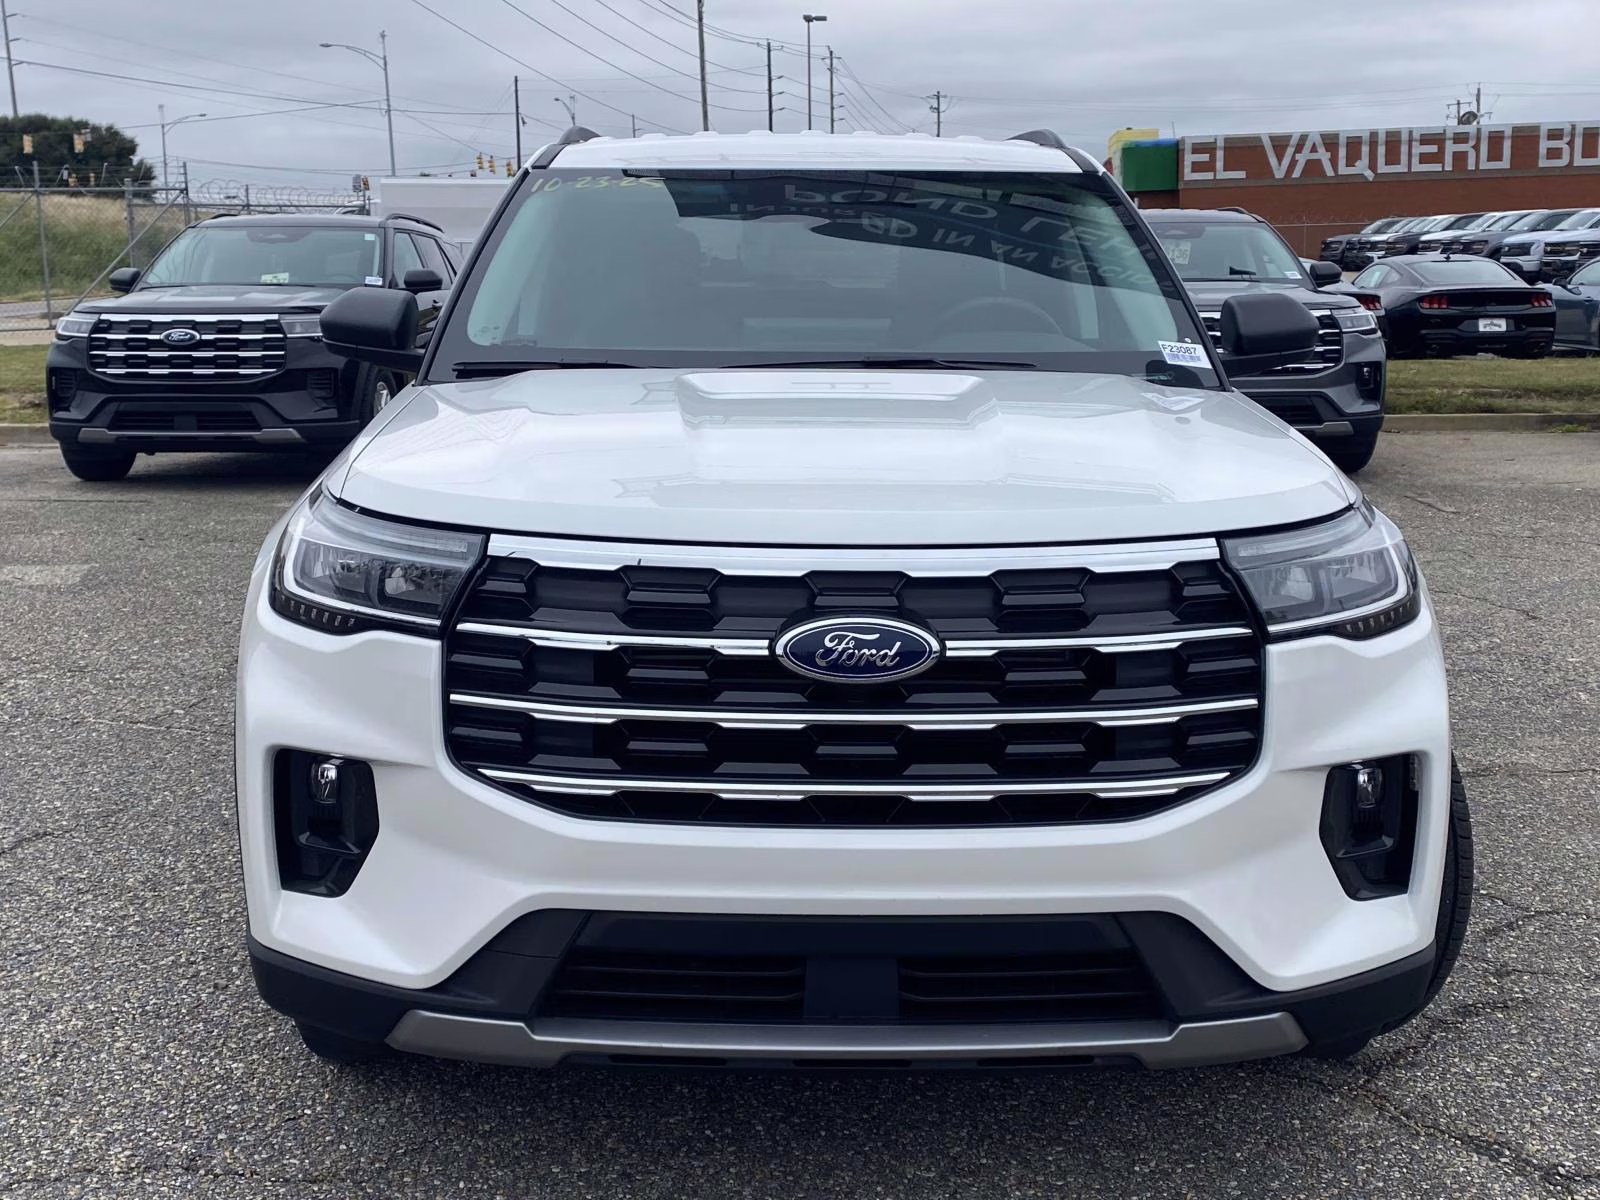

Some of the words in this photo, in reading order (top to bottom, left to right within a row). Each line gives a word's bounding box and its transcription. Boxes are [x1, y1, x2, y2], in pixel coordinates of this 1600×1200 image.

[1183, 134, 1247, 181] EL
[1260, 124, 1513, 181] VAQUERO
[815, 631, 902, 667] Ford
